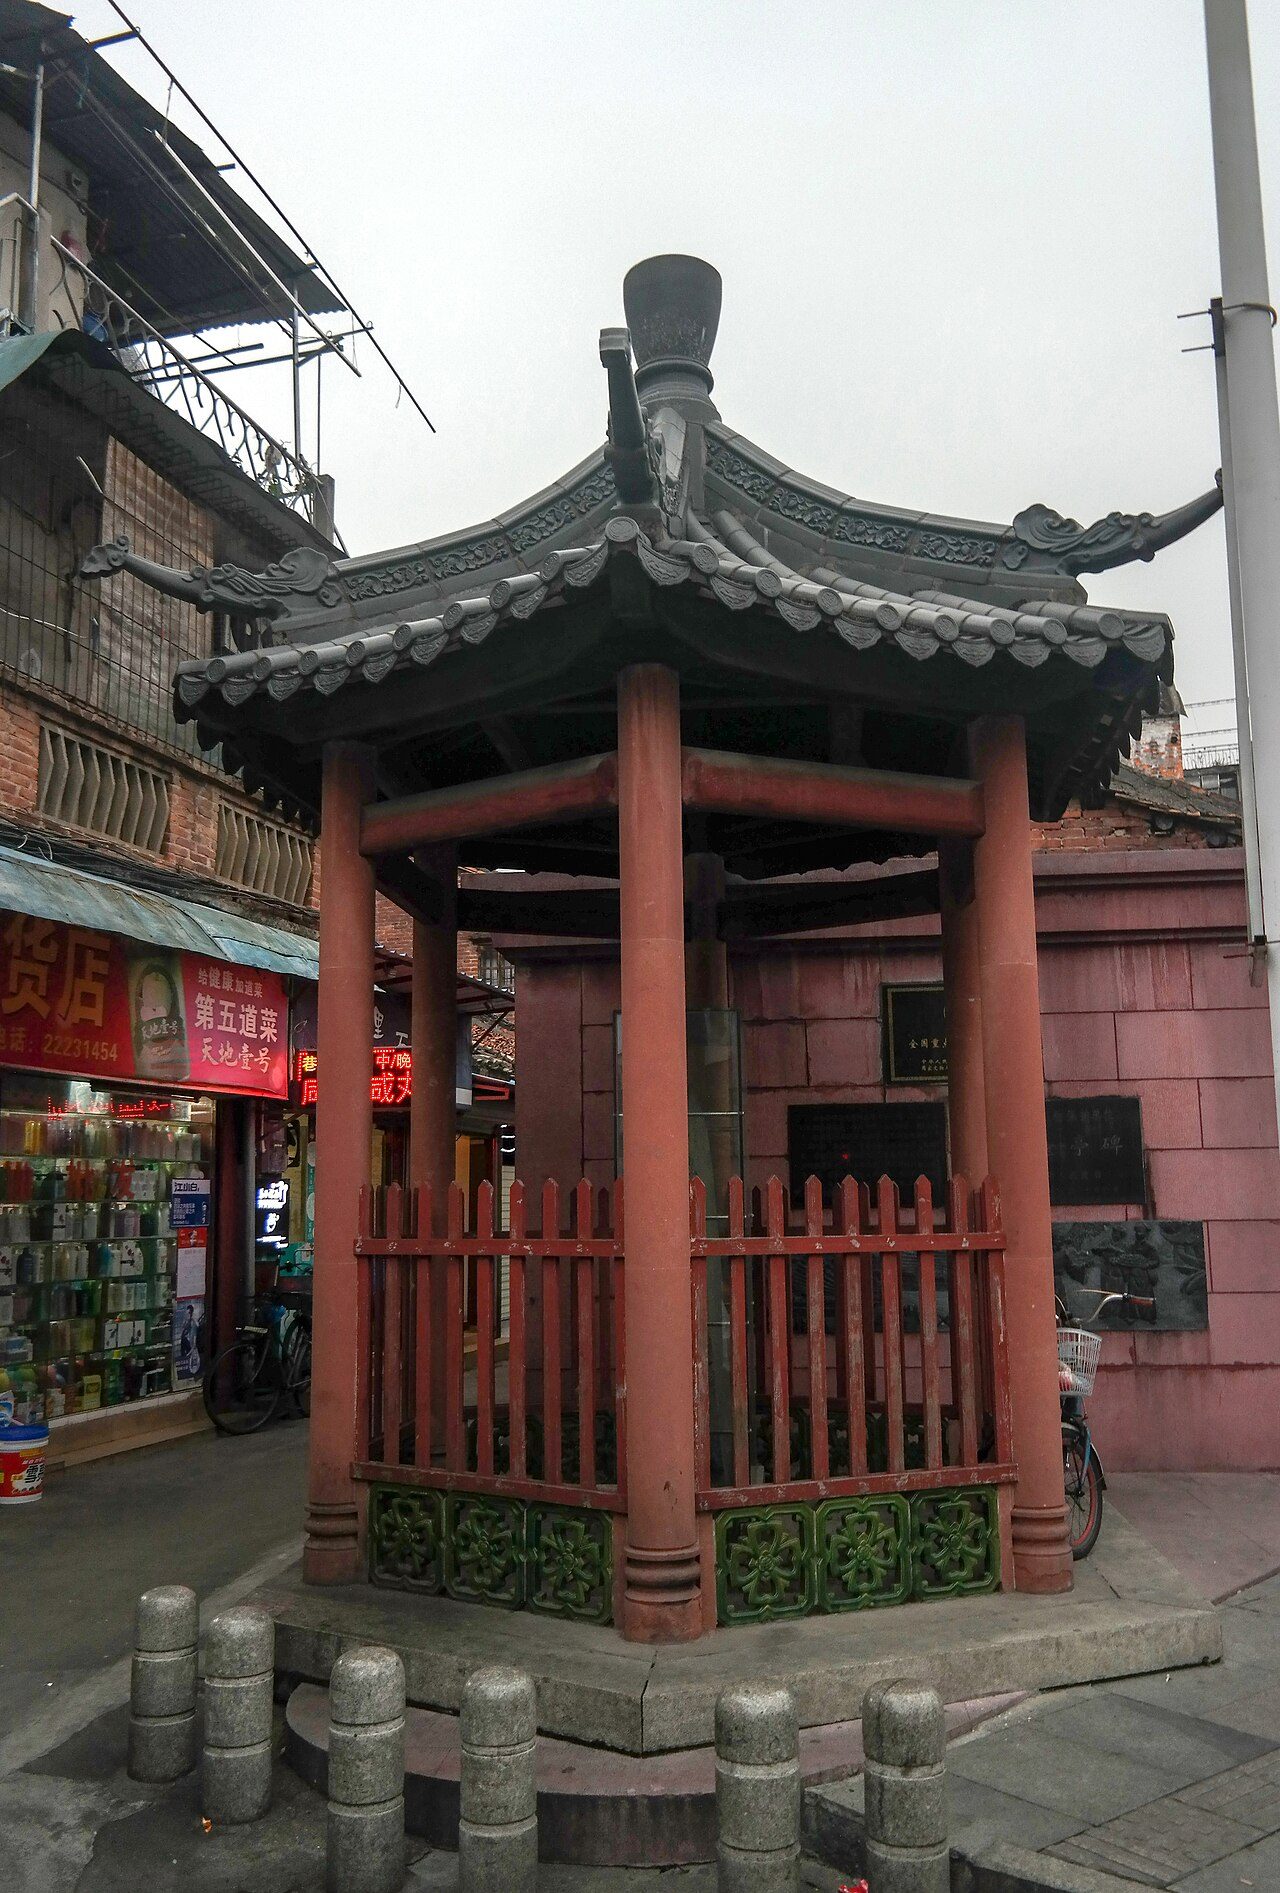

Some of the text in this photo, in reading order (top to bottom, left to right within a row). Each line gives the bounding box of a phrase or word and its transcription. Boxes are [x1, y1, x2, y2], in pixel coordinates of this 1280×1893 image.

[194, 992, 278, 1043] 第五道菜
[44, 1033, 118, 1062] 22231454
[201, 1037, 271, 1074] 天地壹号
